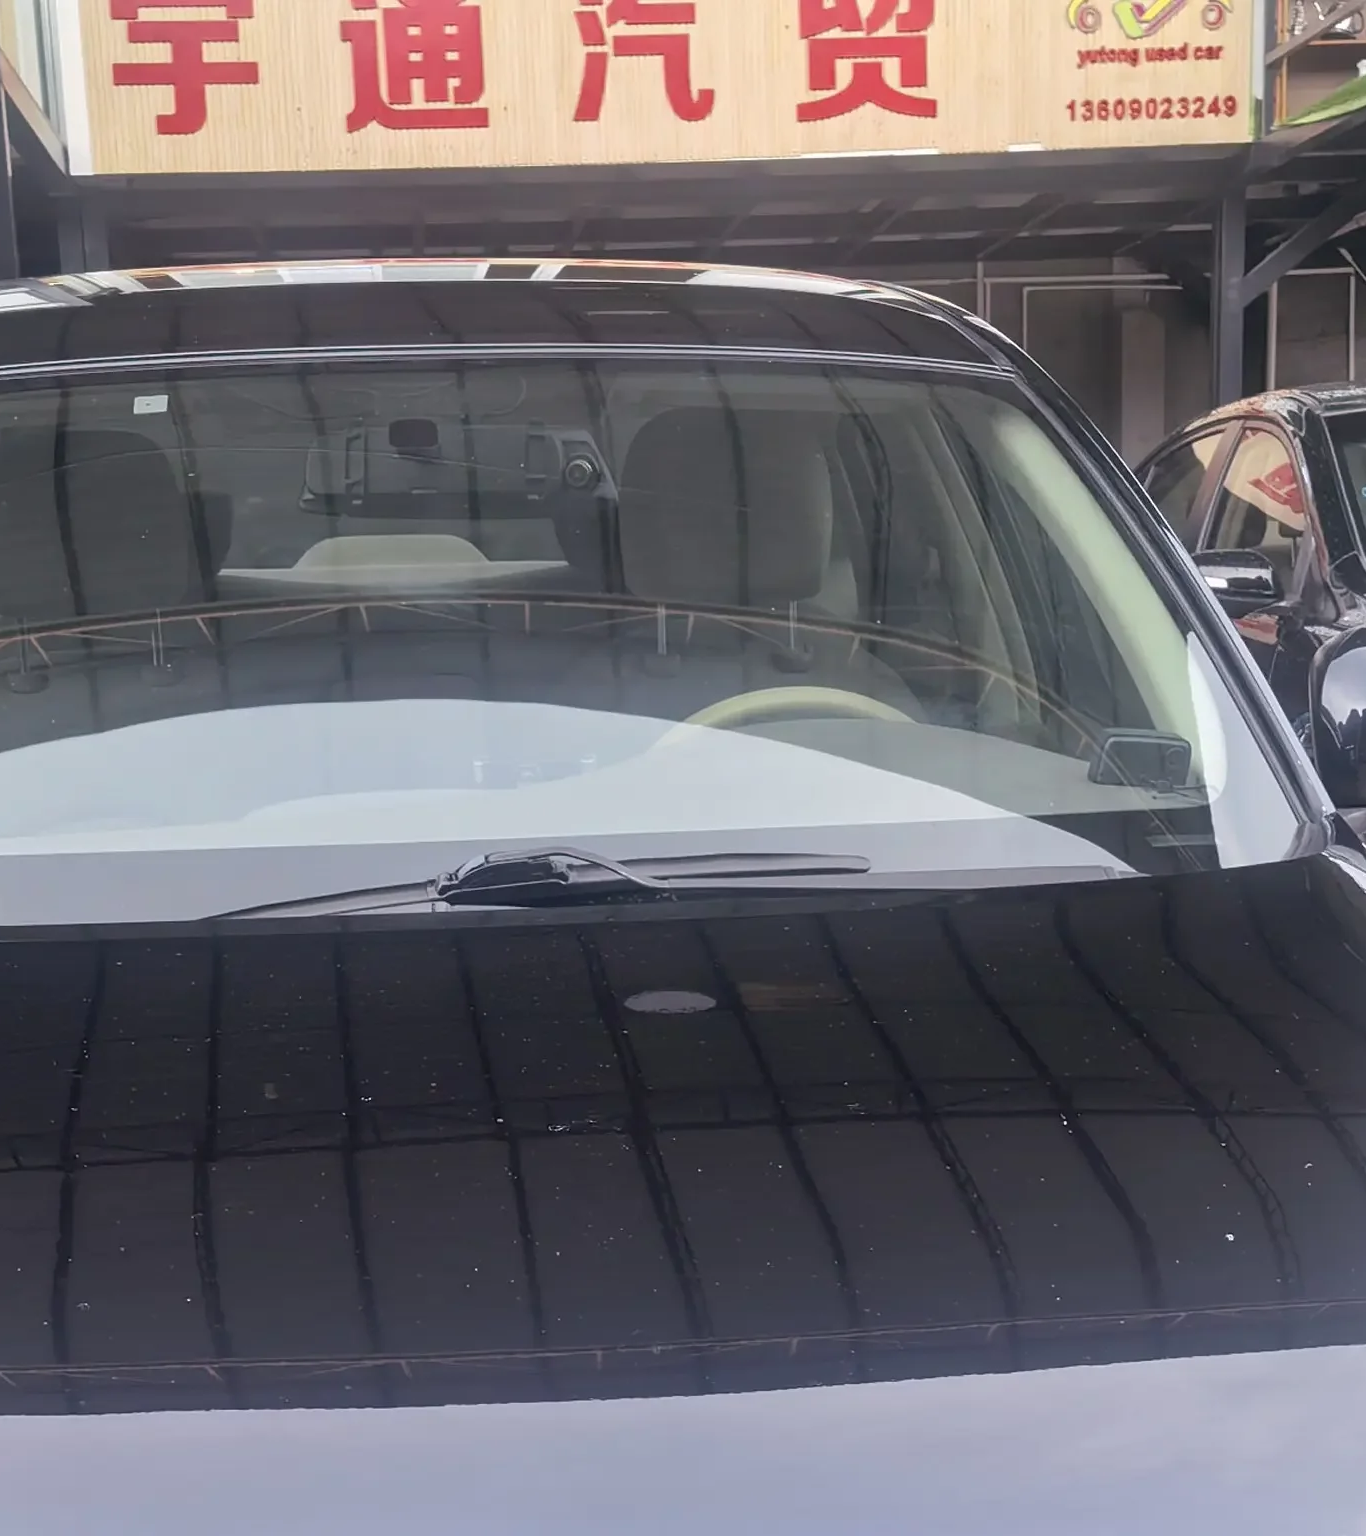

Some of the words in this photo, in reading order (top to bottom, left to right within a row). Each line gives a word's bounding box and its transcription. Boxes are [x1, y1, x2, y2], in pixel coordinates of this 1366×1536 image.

[1076, 45, 1139, 69] yutong
[1145, 42, 1188, 61] used
[1194, 45, 1224, 60] car
[1066, 95, 1238, 121] 13609023249
